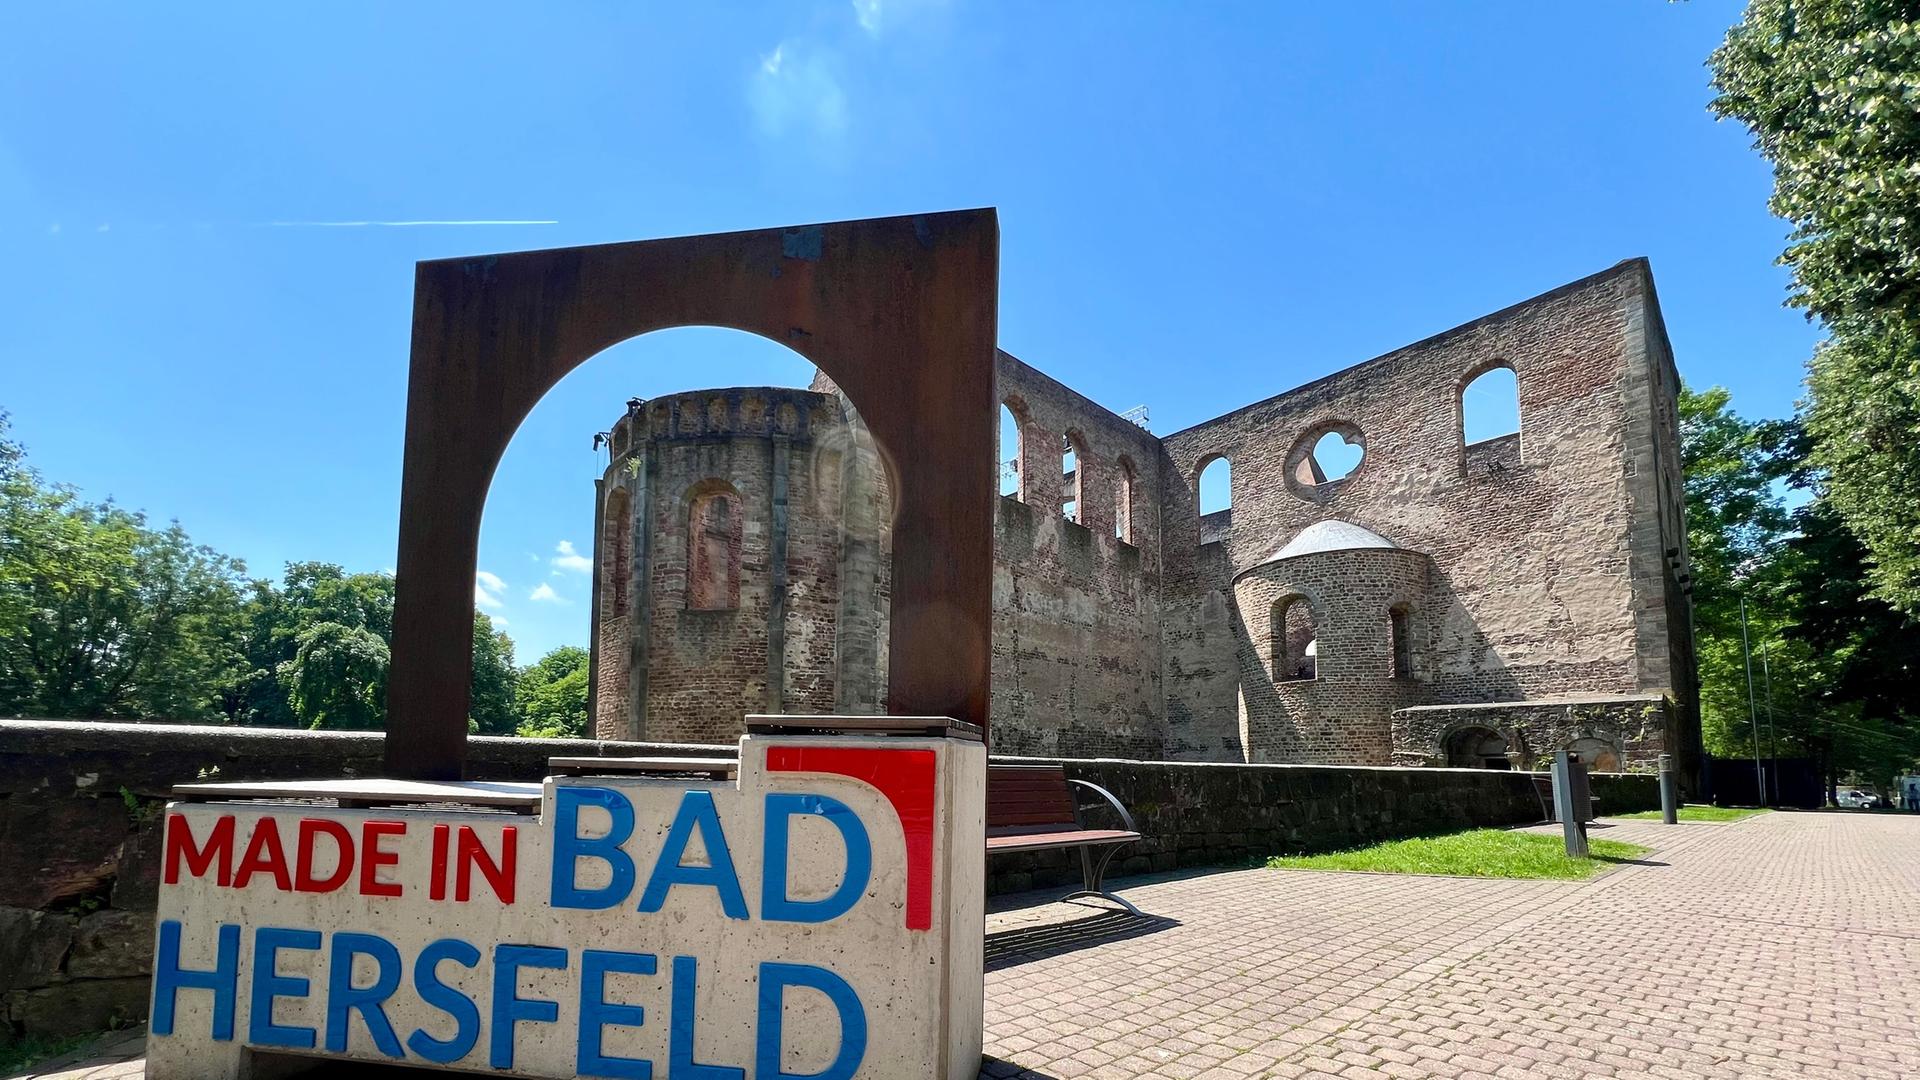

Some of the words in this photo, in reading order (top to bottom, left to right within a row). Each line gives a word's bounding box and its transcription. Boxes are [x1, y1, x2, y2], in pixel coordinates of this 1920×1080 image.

[164, 814, 407, 897] MADE
[429, 825, 518, 906] IN
[550, 785, 872, 923] BAD
[152, 920, 867, 1080] HERSFELD
